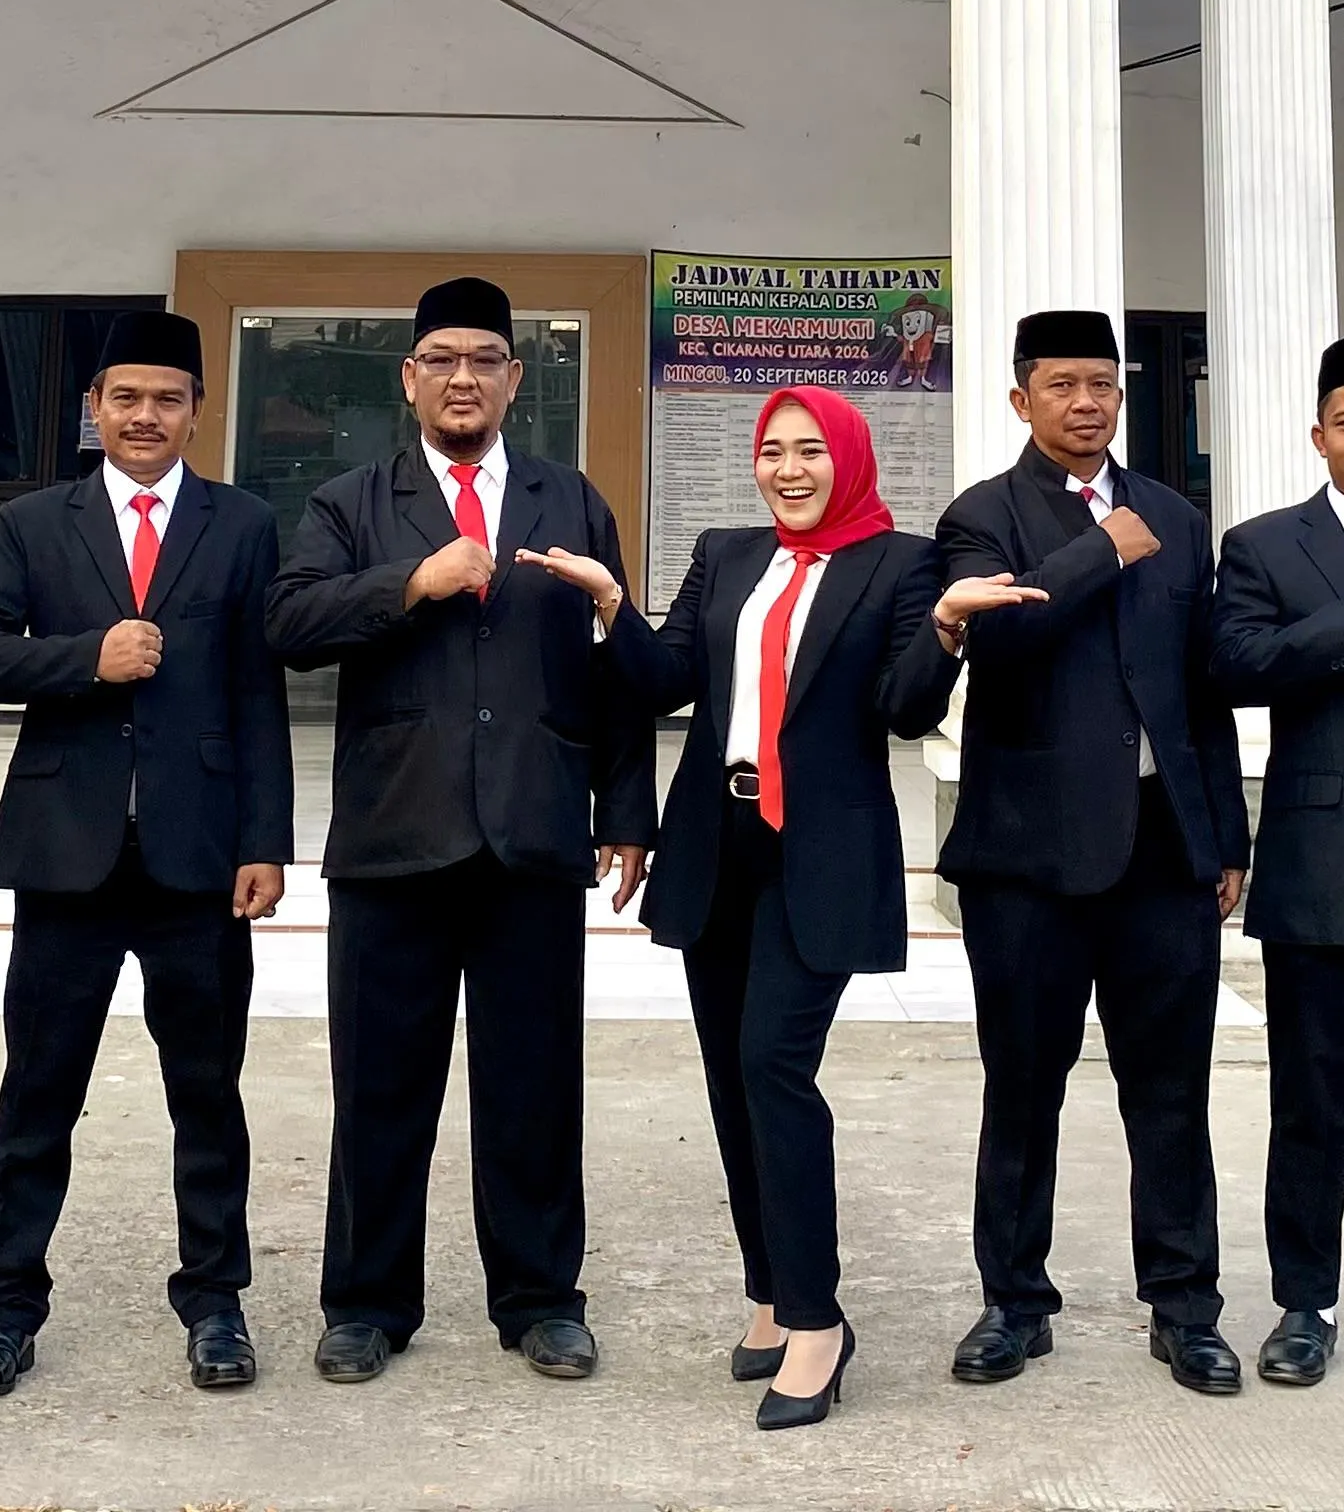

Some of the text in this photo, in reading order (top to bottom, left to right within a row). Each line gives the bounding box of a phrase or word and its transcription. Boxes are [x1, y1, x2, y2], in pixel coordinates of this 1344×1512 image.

[671, 264, 941, 289] JADWAL TAHAPAN
[674, 290, 877, 309] PEMILIHAN KEPALA DESA
[674, 315, 875, 340] DESA MEKARMUKTI
[713, 342, 785, 357] CIKARANG
[788, 345, 831, 358] UTARA
[835, 345, 869, 359] 2026
[734, 368, 752, 382] 20
[756, 368, 847, 385] SEPTEMBER
[852, 370, 888, 385] 2026
